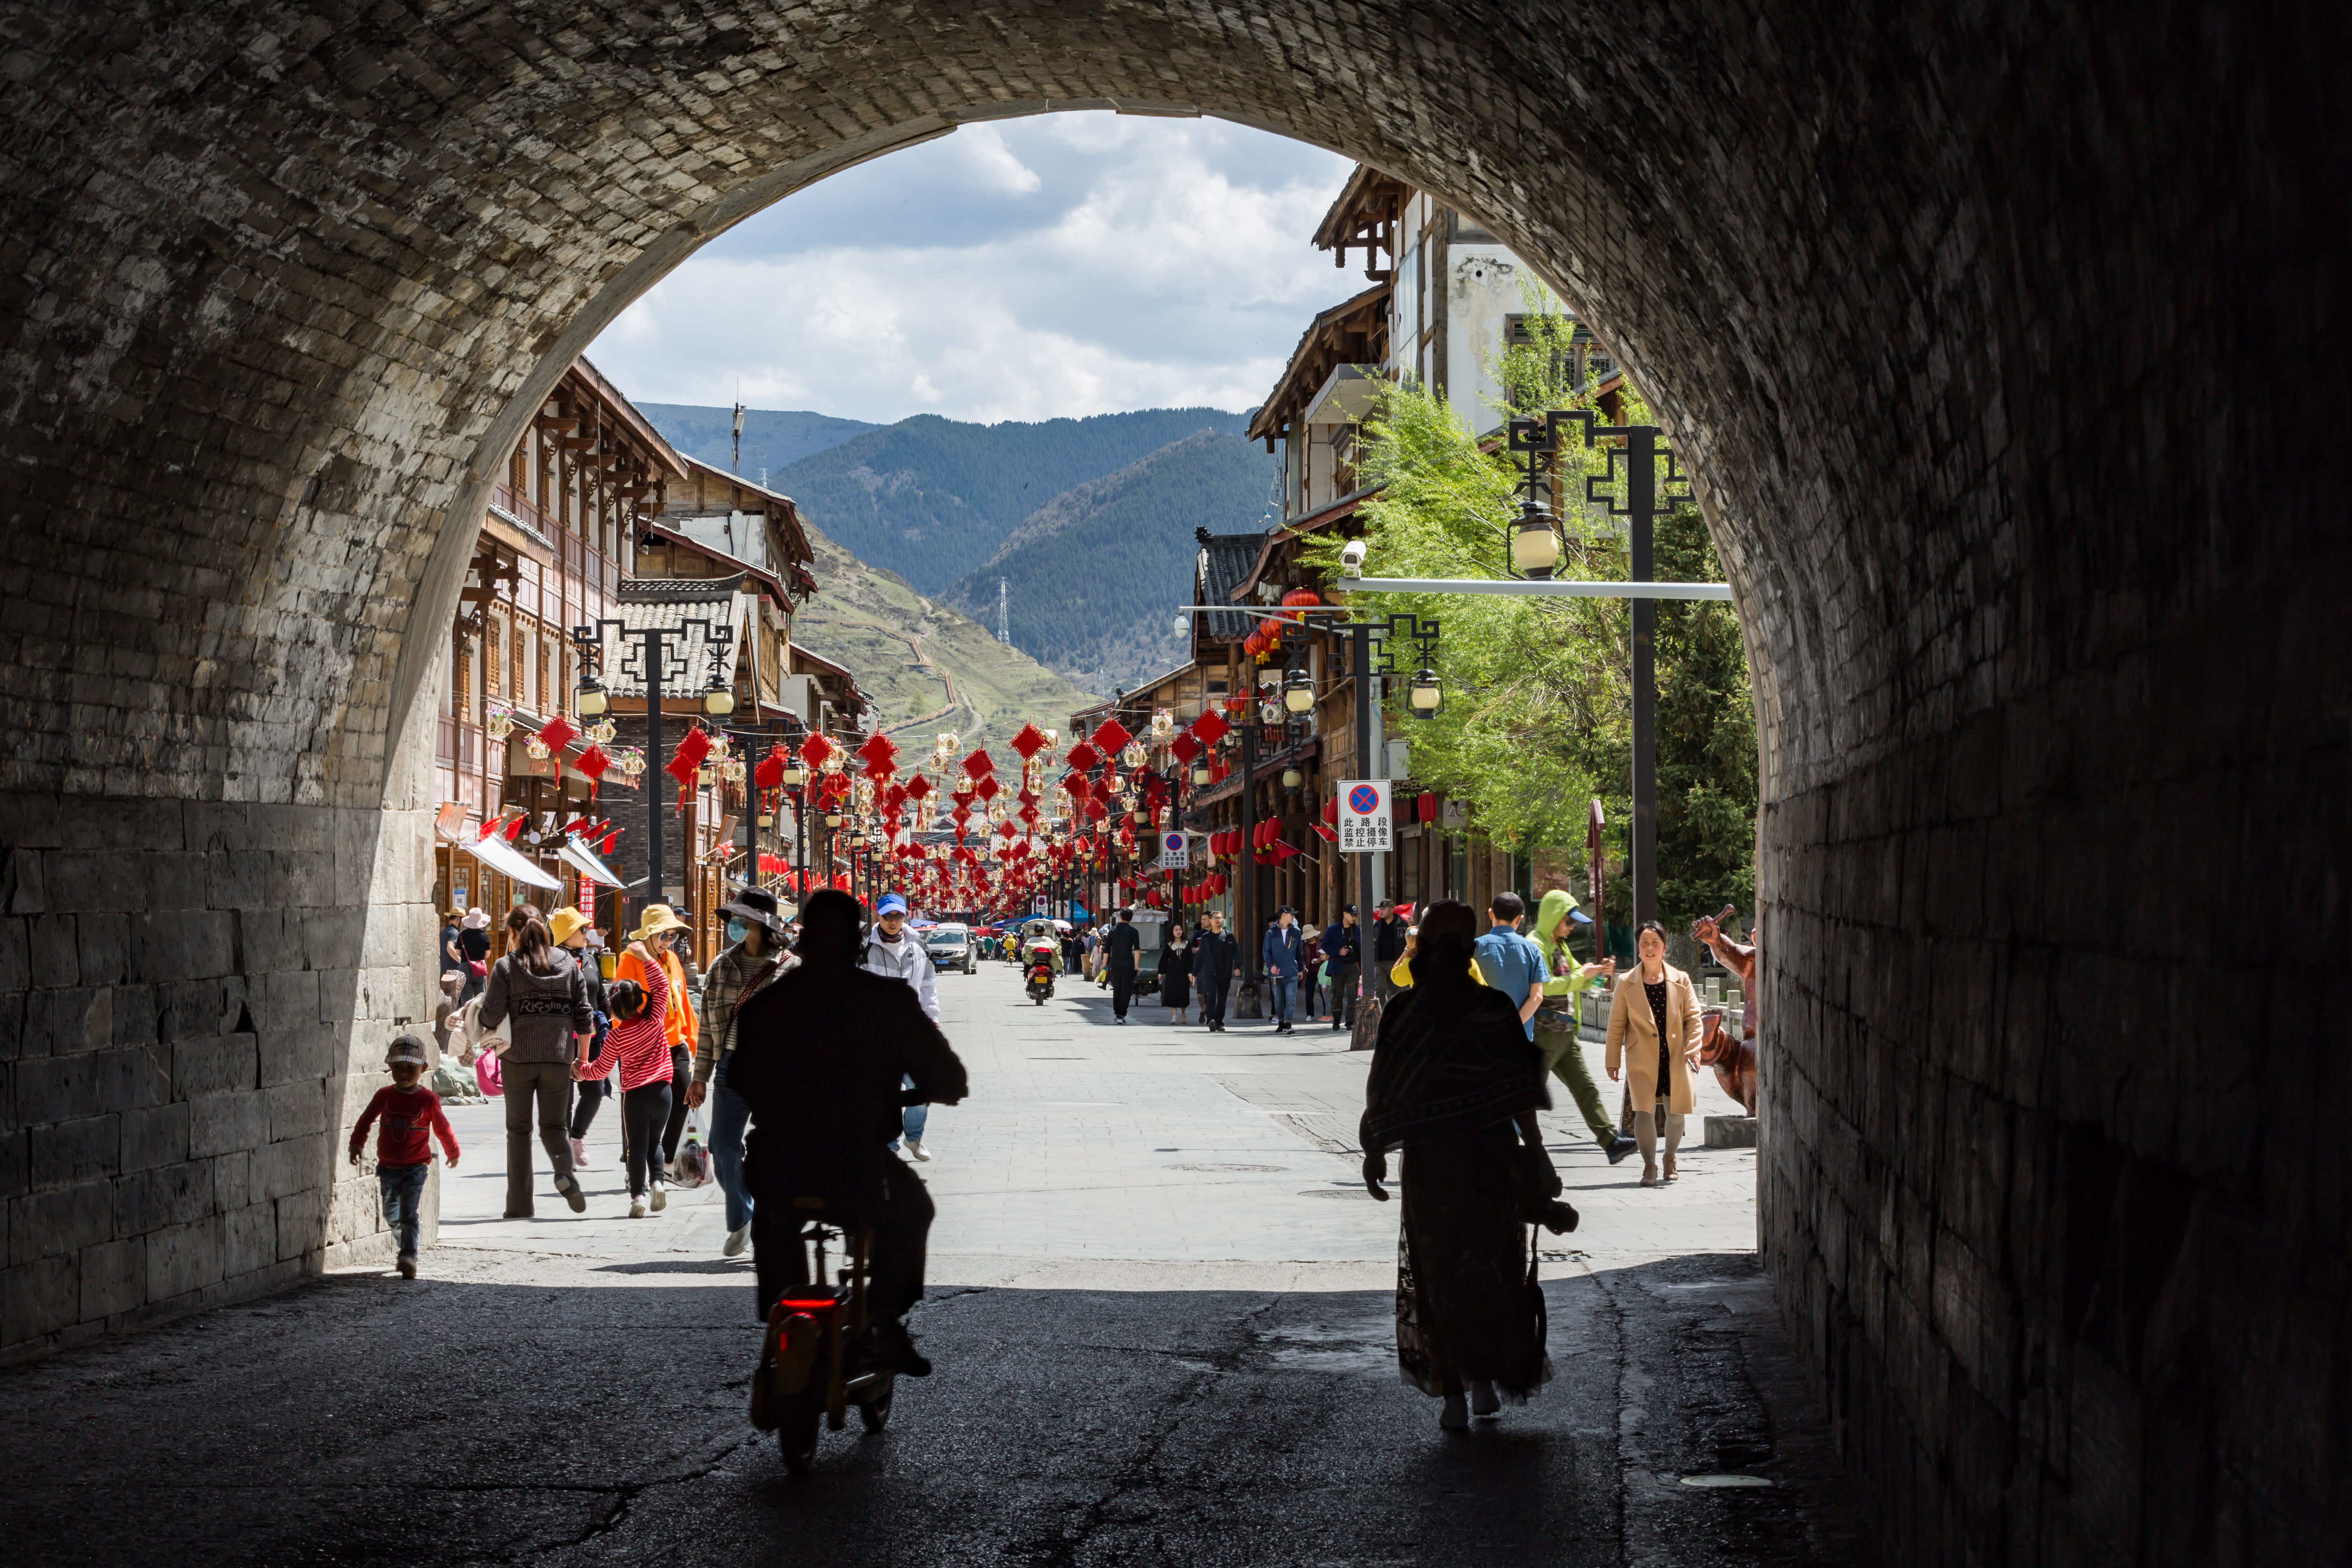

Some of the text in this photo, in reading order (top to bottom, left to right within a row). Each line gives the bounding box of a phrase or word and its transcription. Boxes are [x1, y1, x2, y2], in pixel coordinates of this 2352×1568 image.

[1344, 817, 1387, 827] 此路段
[1344, 827, 1388, 837] 监控摄像
[1345, 837, 1388, 847] 禁止停车
